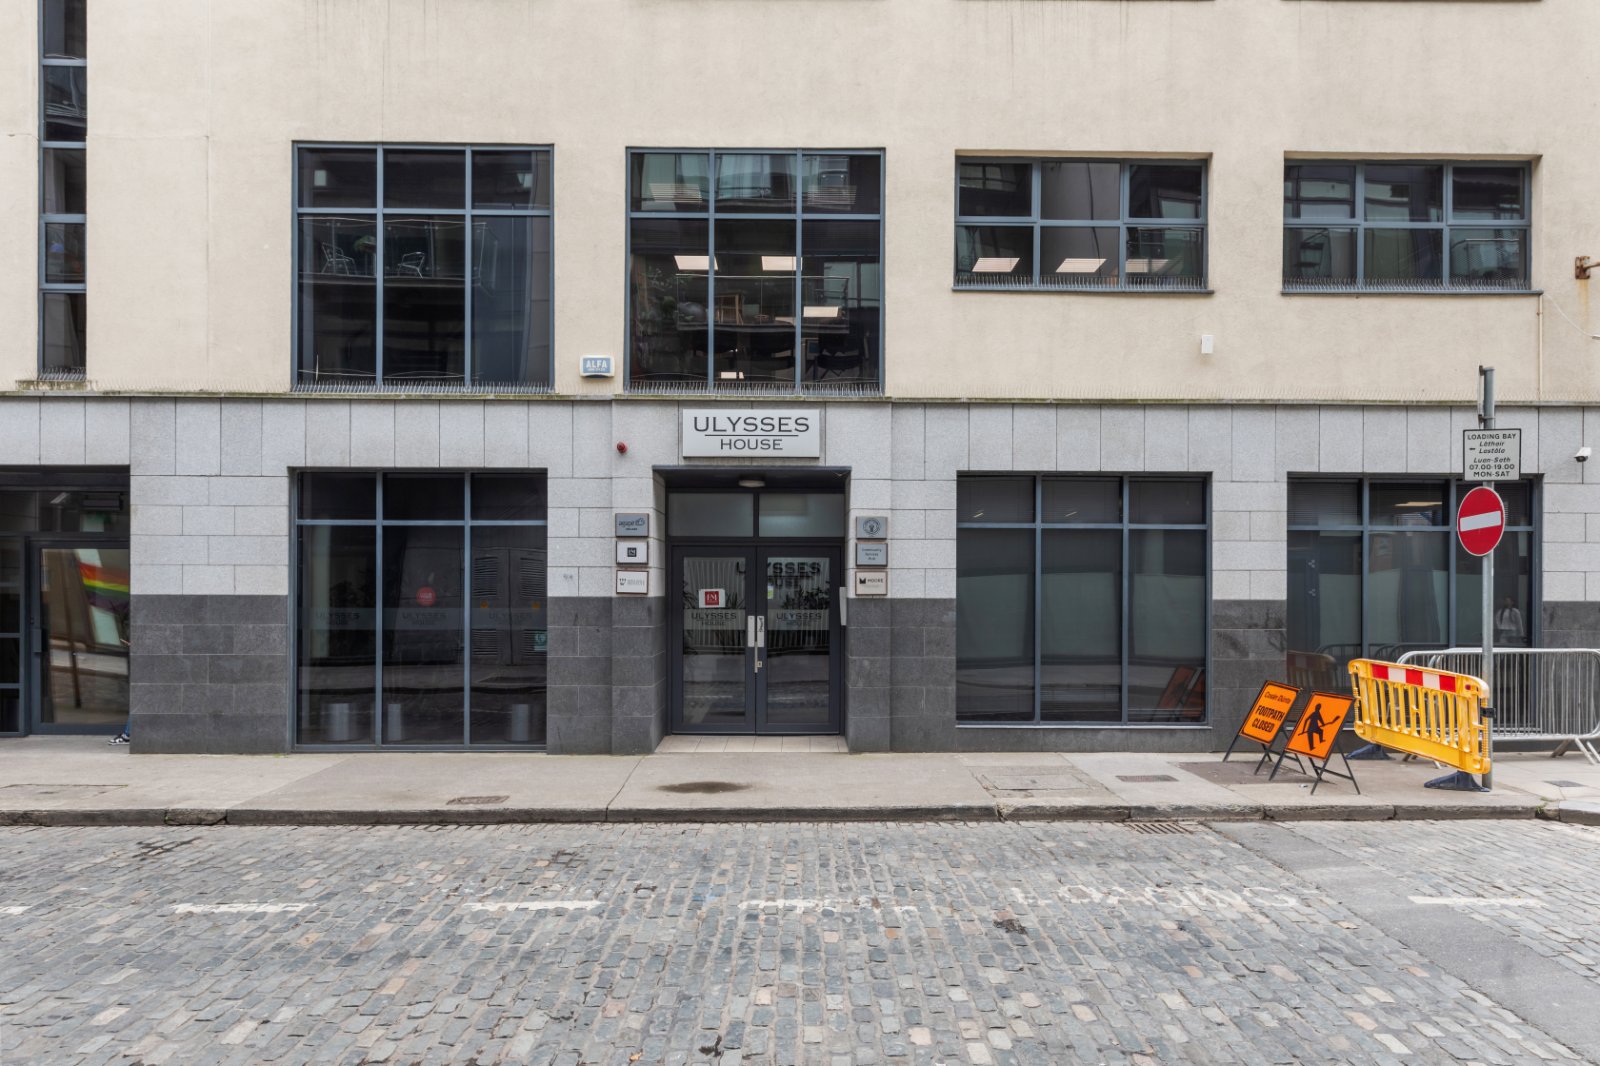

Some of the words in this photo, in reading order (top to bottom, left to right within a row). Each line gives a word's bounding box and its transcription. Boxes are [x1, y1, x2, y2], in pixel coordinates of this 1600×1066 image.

[585, 359, 608, 369] ALFA
[693, 416, 810, 433] ULYSSES
[720, 438, 783, 451] HOUSE
[691, 612, 737, 620] ULYSSES
[1255, 705, 1285, 721] FOOTPATH
[1252, 718, 1275, 732] CLOSED
